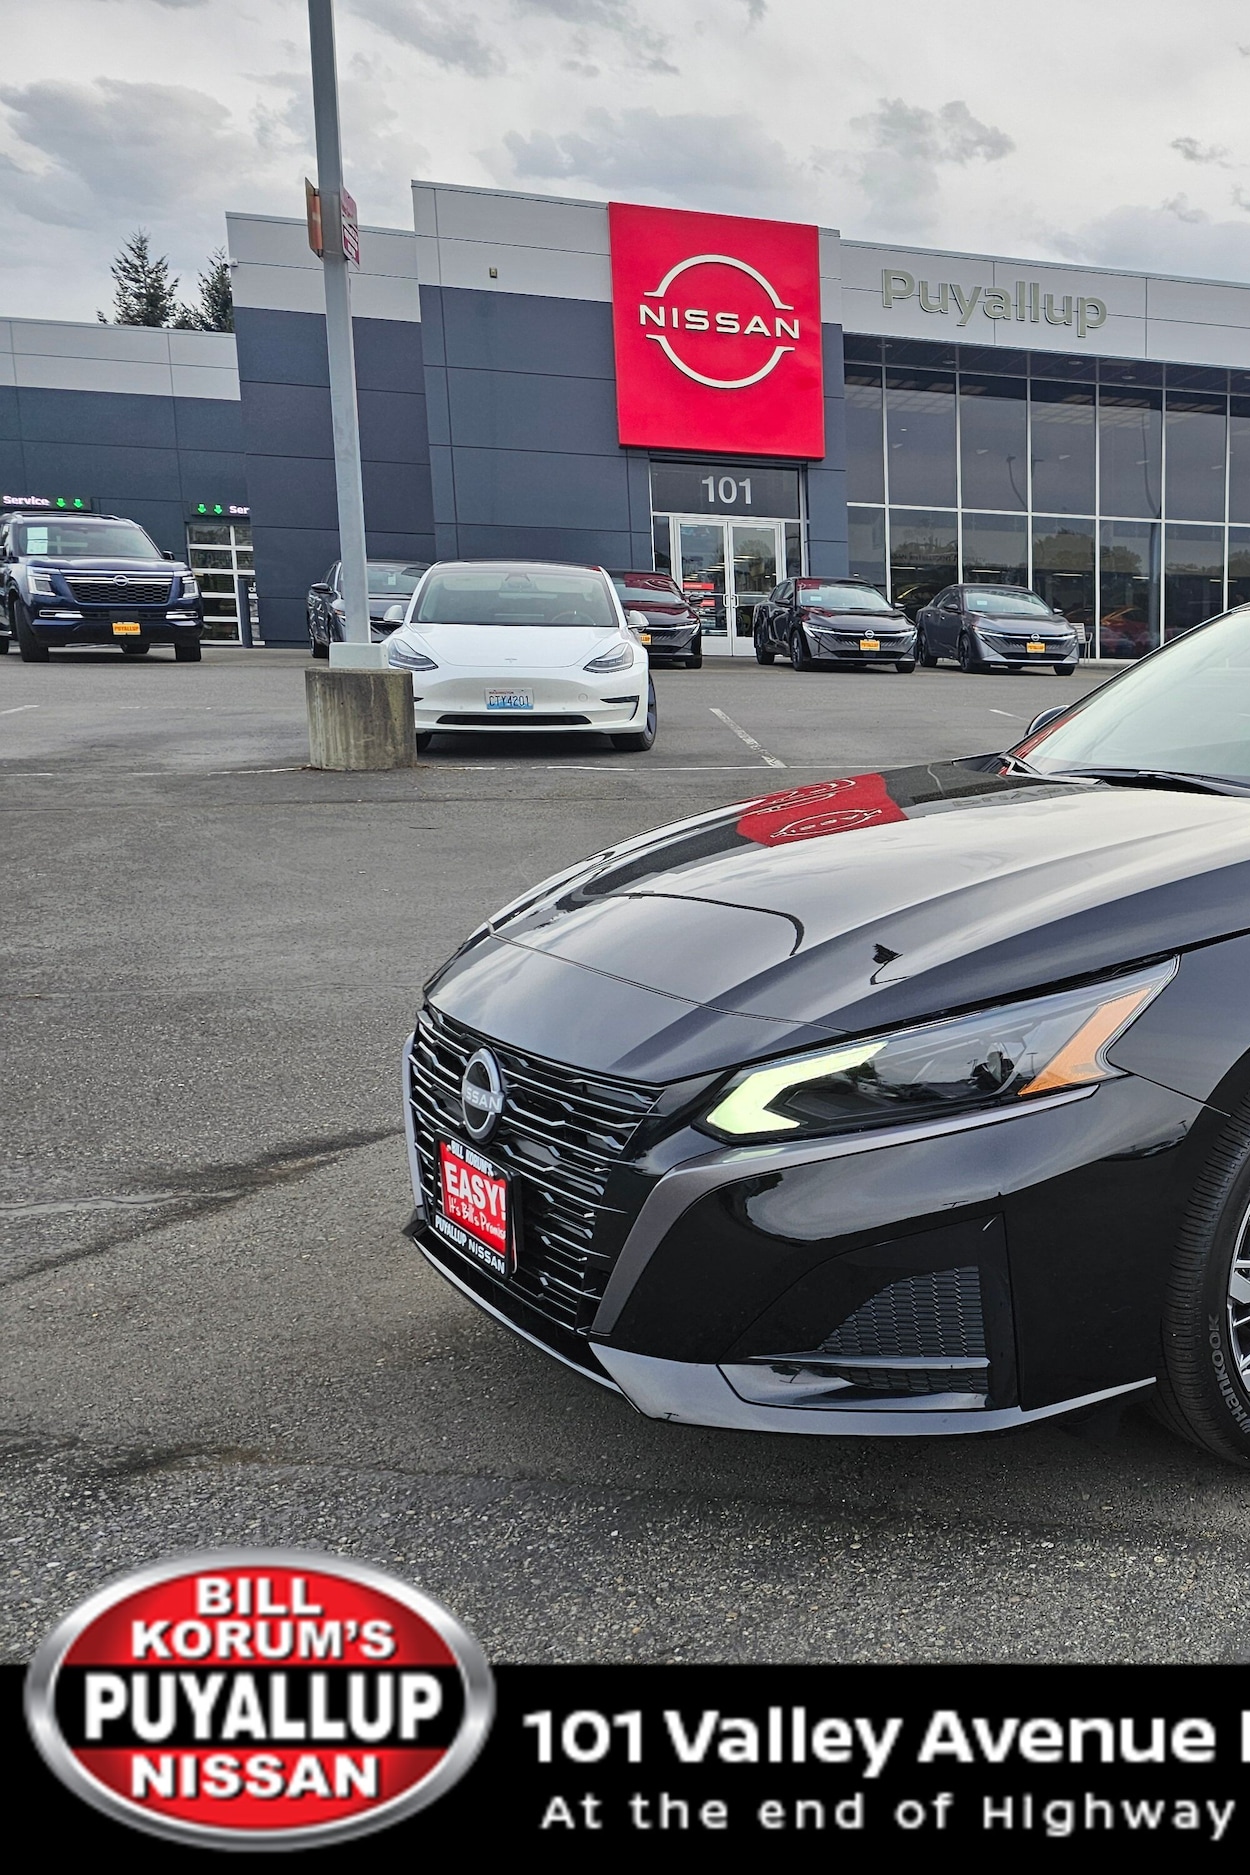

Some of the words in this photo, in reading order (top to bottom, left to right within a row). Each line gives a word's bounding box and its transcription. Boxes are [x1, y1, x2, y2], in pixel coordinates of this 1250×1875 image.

[639, 304, 799, 339] NISSAN
[883, 268, 1107, 338] Puyallup
[2, 495, 50, 506] Service
[701, 476, 752, 505] 101
[443, 1160, 506, 1221] EASY!
[435, 1214, 467, 1247] PUYALLUP
[468, 1239, 505, 1275] NISSAN
